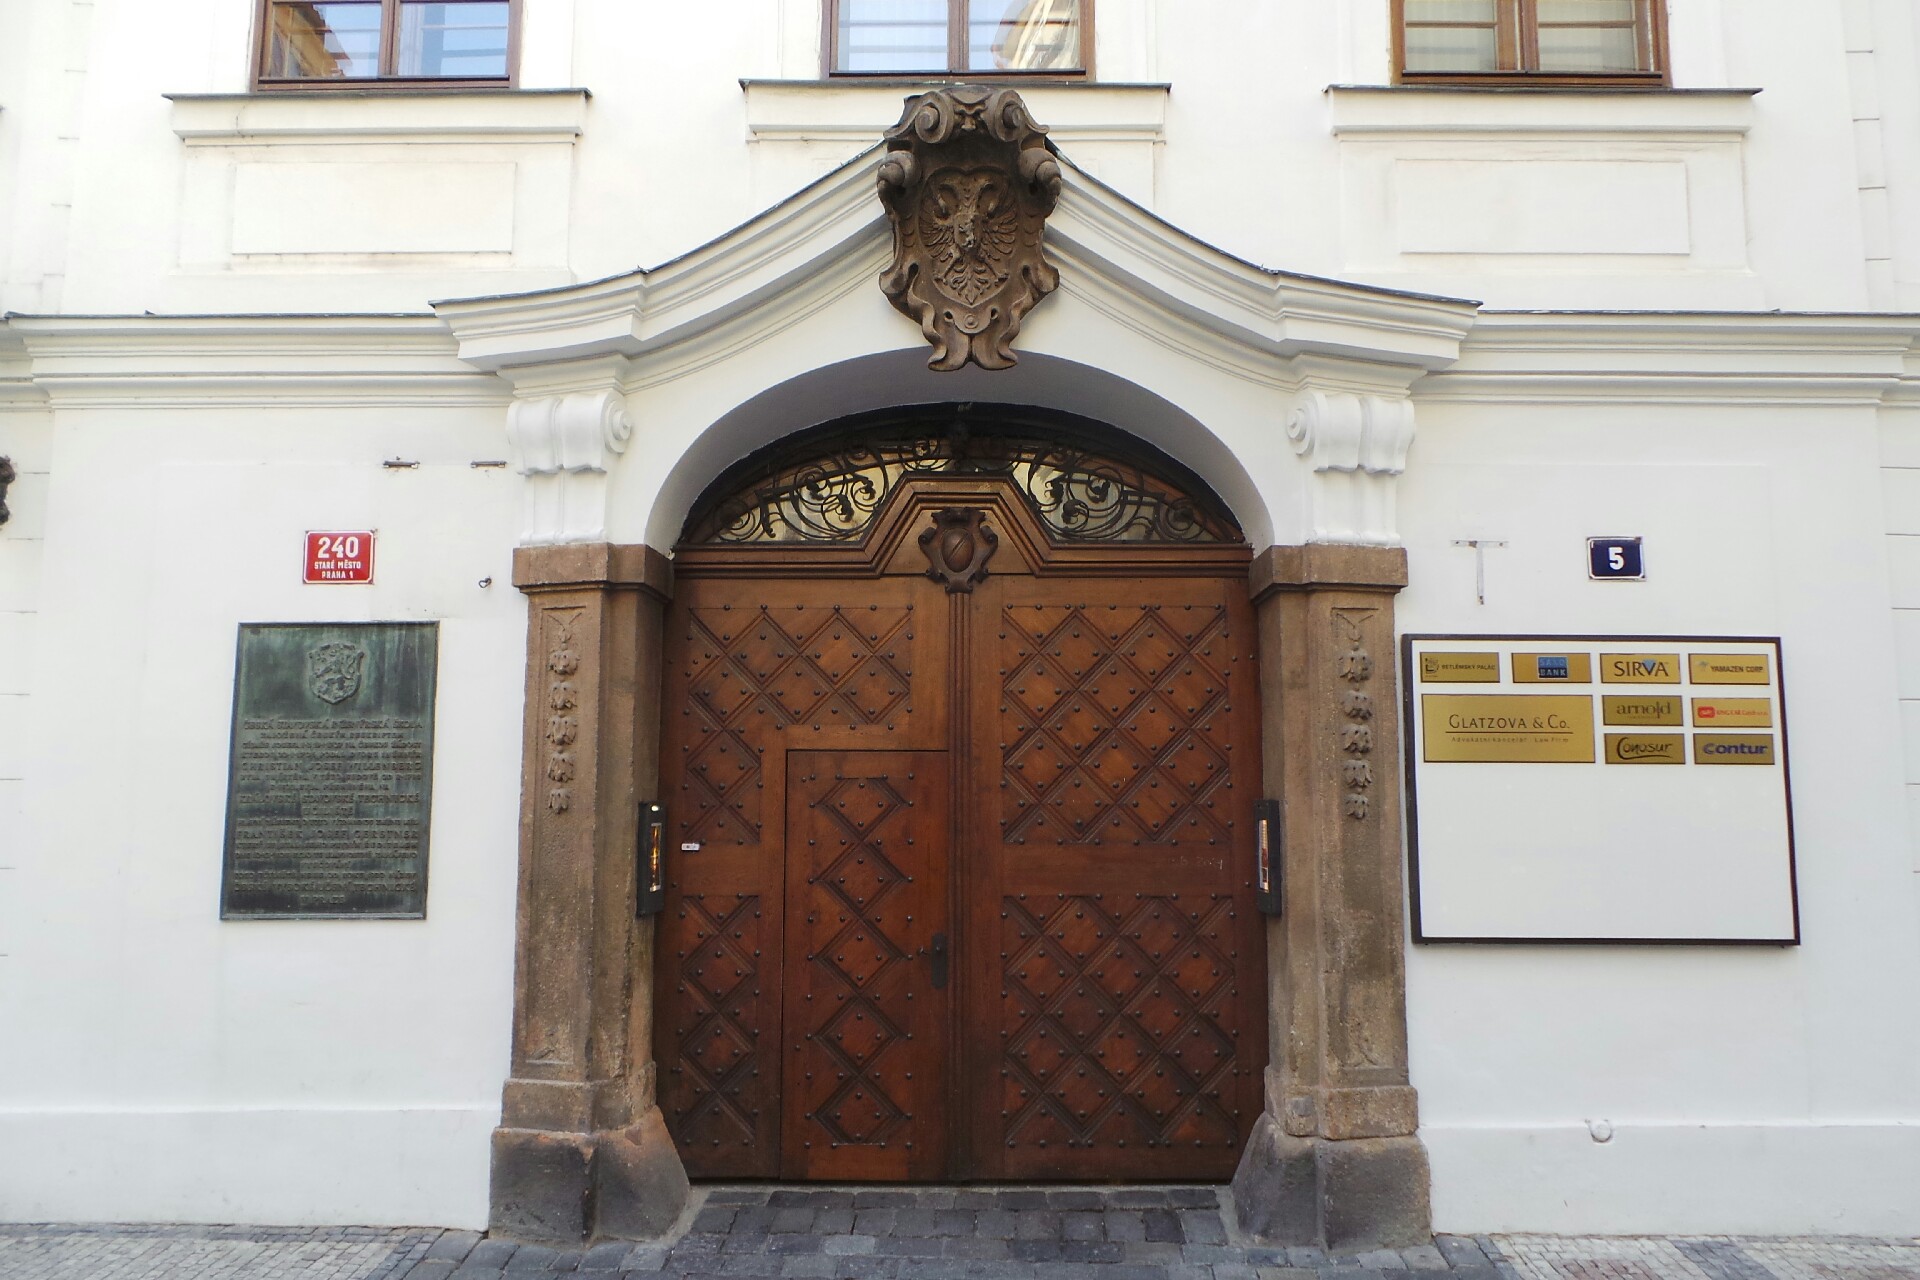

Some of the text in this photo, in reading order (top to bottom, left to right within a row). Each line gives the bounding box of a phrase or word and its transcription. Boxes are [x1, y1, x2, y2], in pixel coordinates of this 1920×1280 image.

[317, 536, 359, 559] 240
[314, 559, 362, 570] STARÉ MĚSTO
[1608, 546, 1625, 570] 5
[321, 570, 354, 579] PRAHA 1
[1539, 668, 1566, 677] BANK
[1710, 665, 1744, 673] YAMAZEN
[1616, 701, 1671, 719] arnold
[1449, 713, 1528, 729] GLATZOVA
[1533, 717, 1544, 729] &
[1702, 742, 1768, 755] Contur
